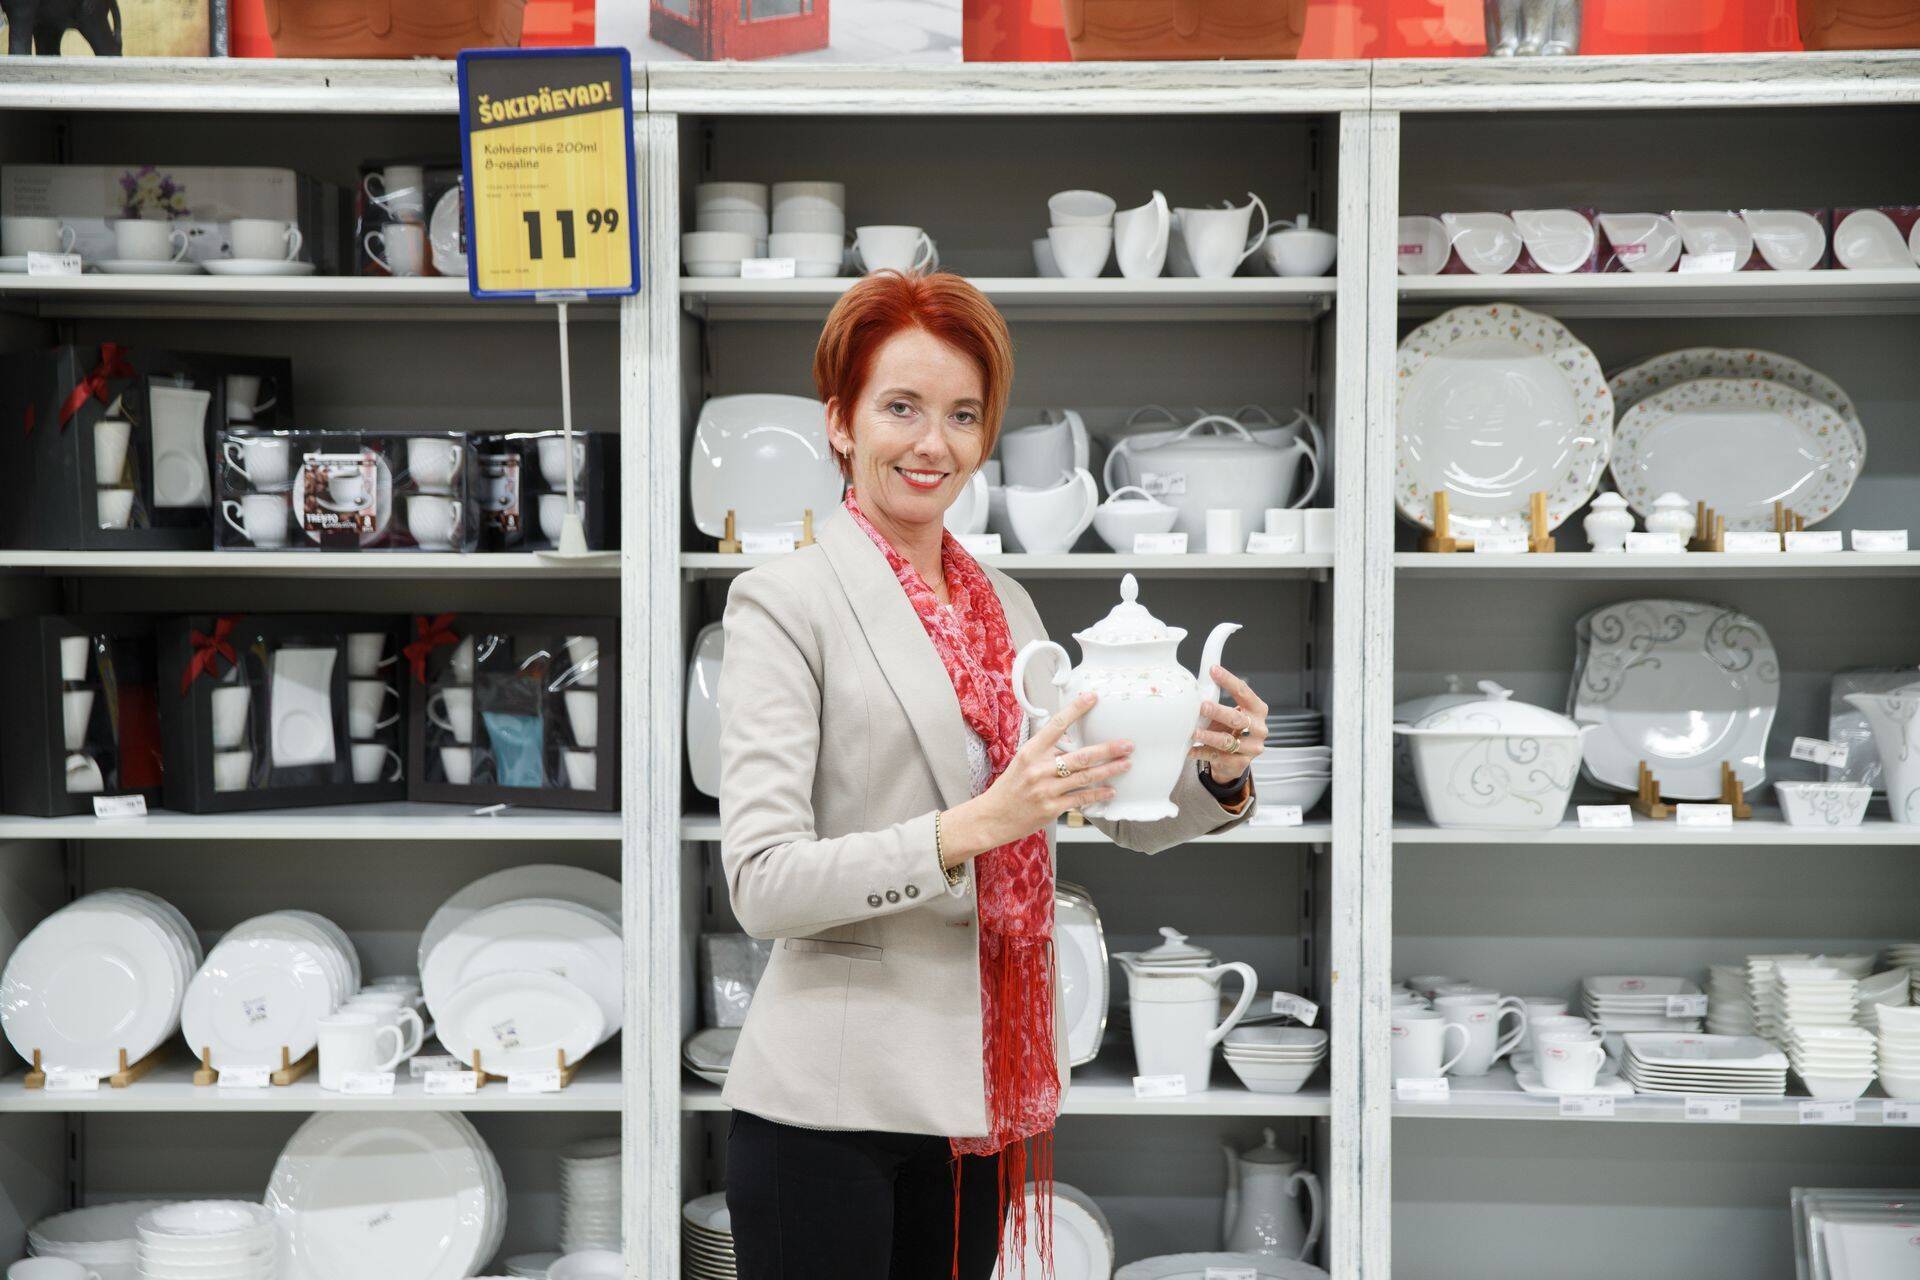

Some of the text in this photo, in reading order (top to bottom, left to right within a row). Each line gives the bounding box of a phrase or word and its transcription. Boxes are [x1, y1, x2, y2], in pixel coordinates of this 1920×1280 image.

[478, 81, 612, 124] ŠOKIPÄEVAD!
[556, 142, 597, 154] 200ml
[485, 158, 540, 170] 8-osaline
[523, 208, 619, 260] 11 99
